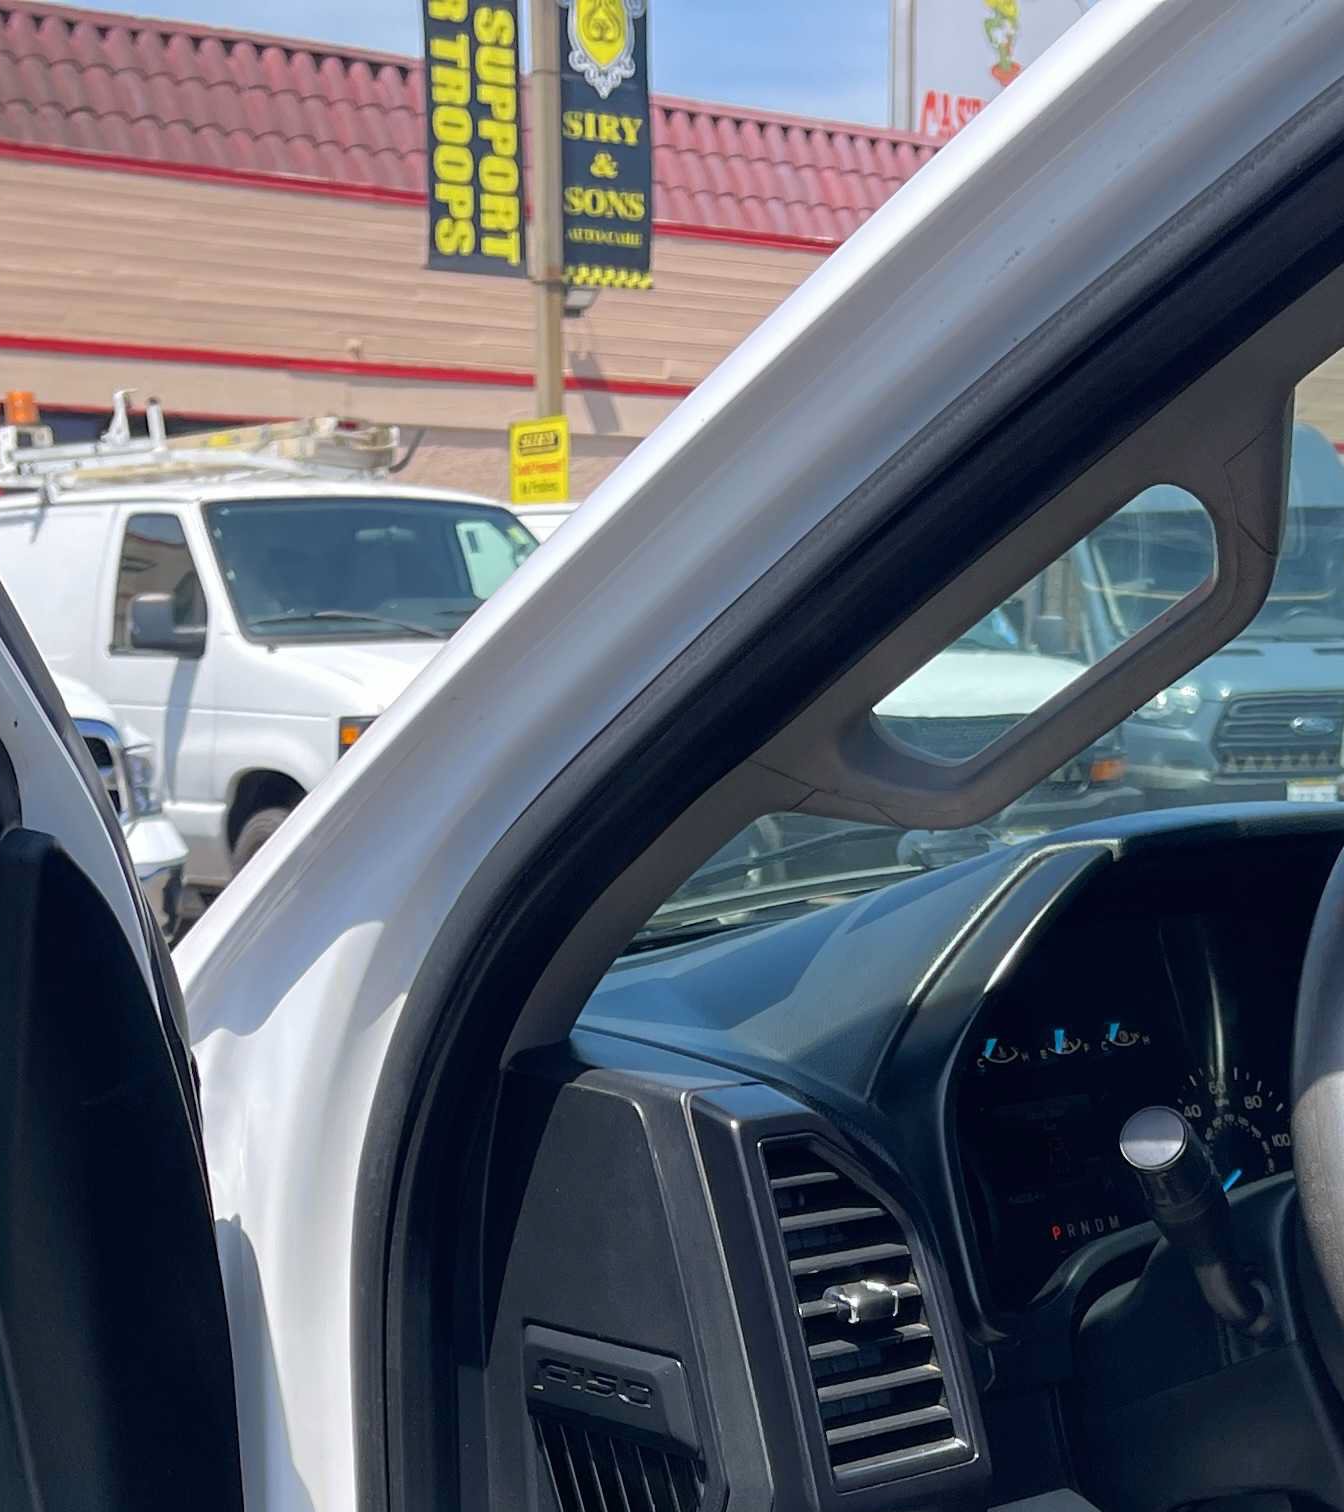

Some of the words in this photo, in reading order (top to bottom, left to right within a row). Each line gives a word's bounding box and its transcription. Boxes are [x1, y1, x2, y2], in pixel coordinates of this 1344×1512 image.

[474, 7, 520, 265] SUPPORT
[562, 110, 643, 146] SIRY
[430, 33, 475, 255] TROOPS
[590, 152, 618, 178] &
[564, 186, 645, 220] SONS
[1183, 1104, 1202, 1118] 40
[1244, 1095, 1262, 1109] 80
[1272, 1133, 1291, 1147] 100
[1051, 1225, 1062, 1241] P
[1067, 1223, 1076, 1237] R
[1081, 1221, 1090, 1235] N
[1095, 1218, 1104, 1232] D
